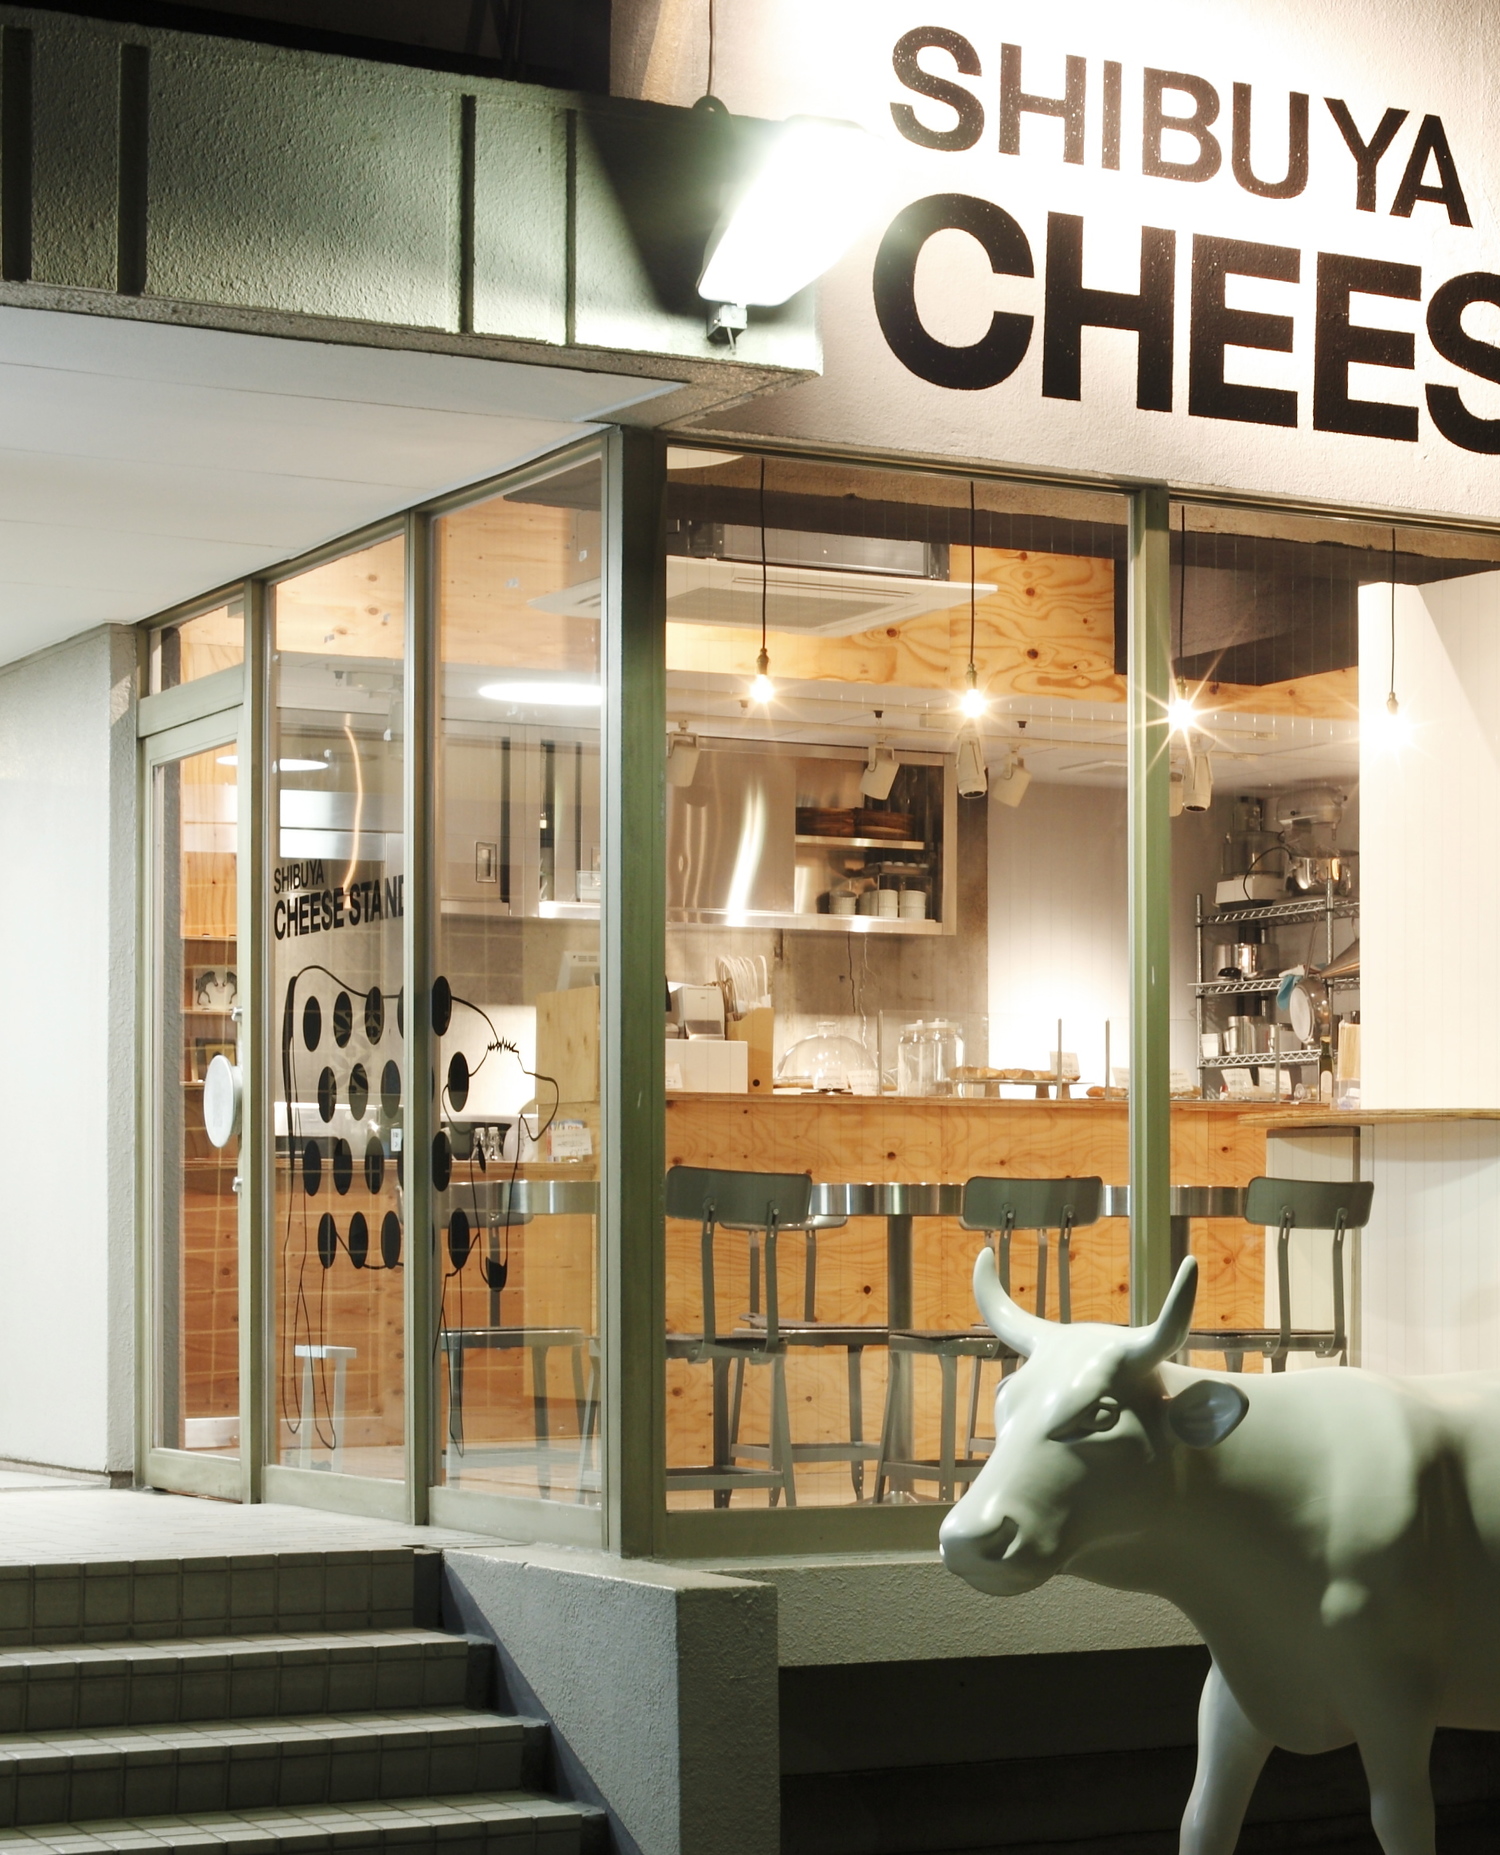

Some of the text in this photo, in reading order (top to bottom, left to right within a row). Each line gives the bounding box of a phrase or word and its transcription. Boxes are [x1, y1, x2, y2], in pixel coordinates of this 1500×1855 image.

[889, 25, 1473, 228] SHIBUYA
[274, 859, 325, 894] SHIBUYA
[274, 887, 345, 940] CHEESE
